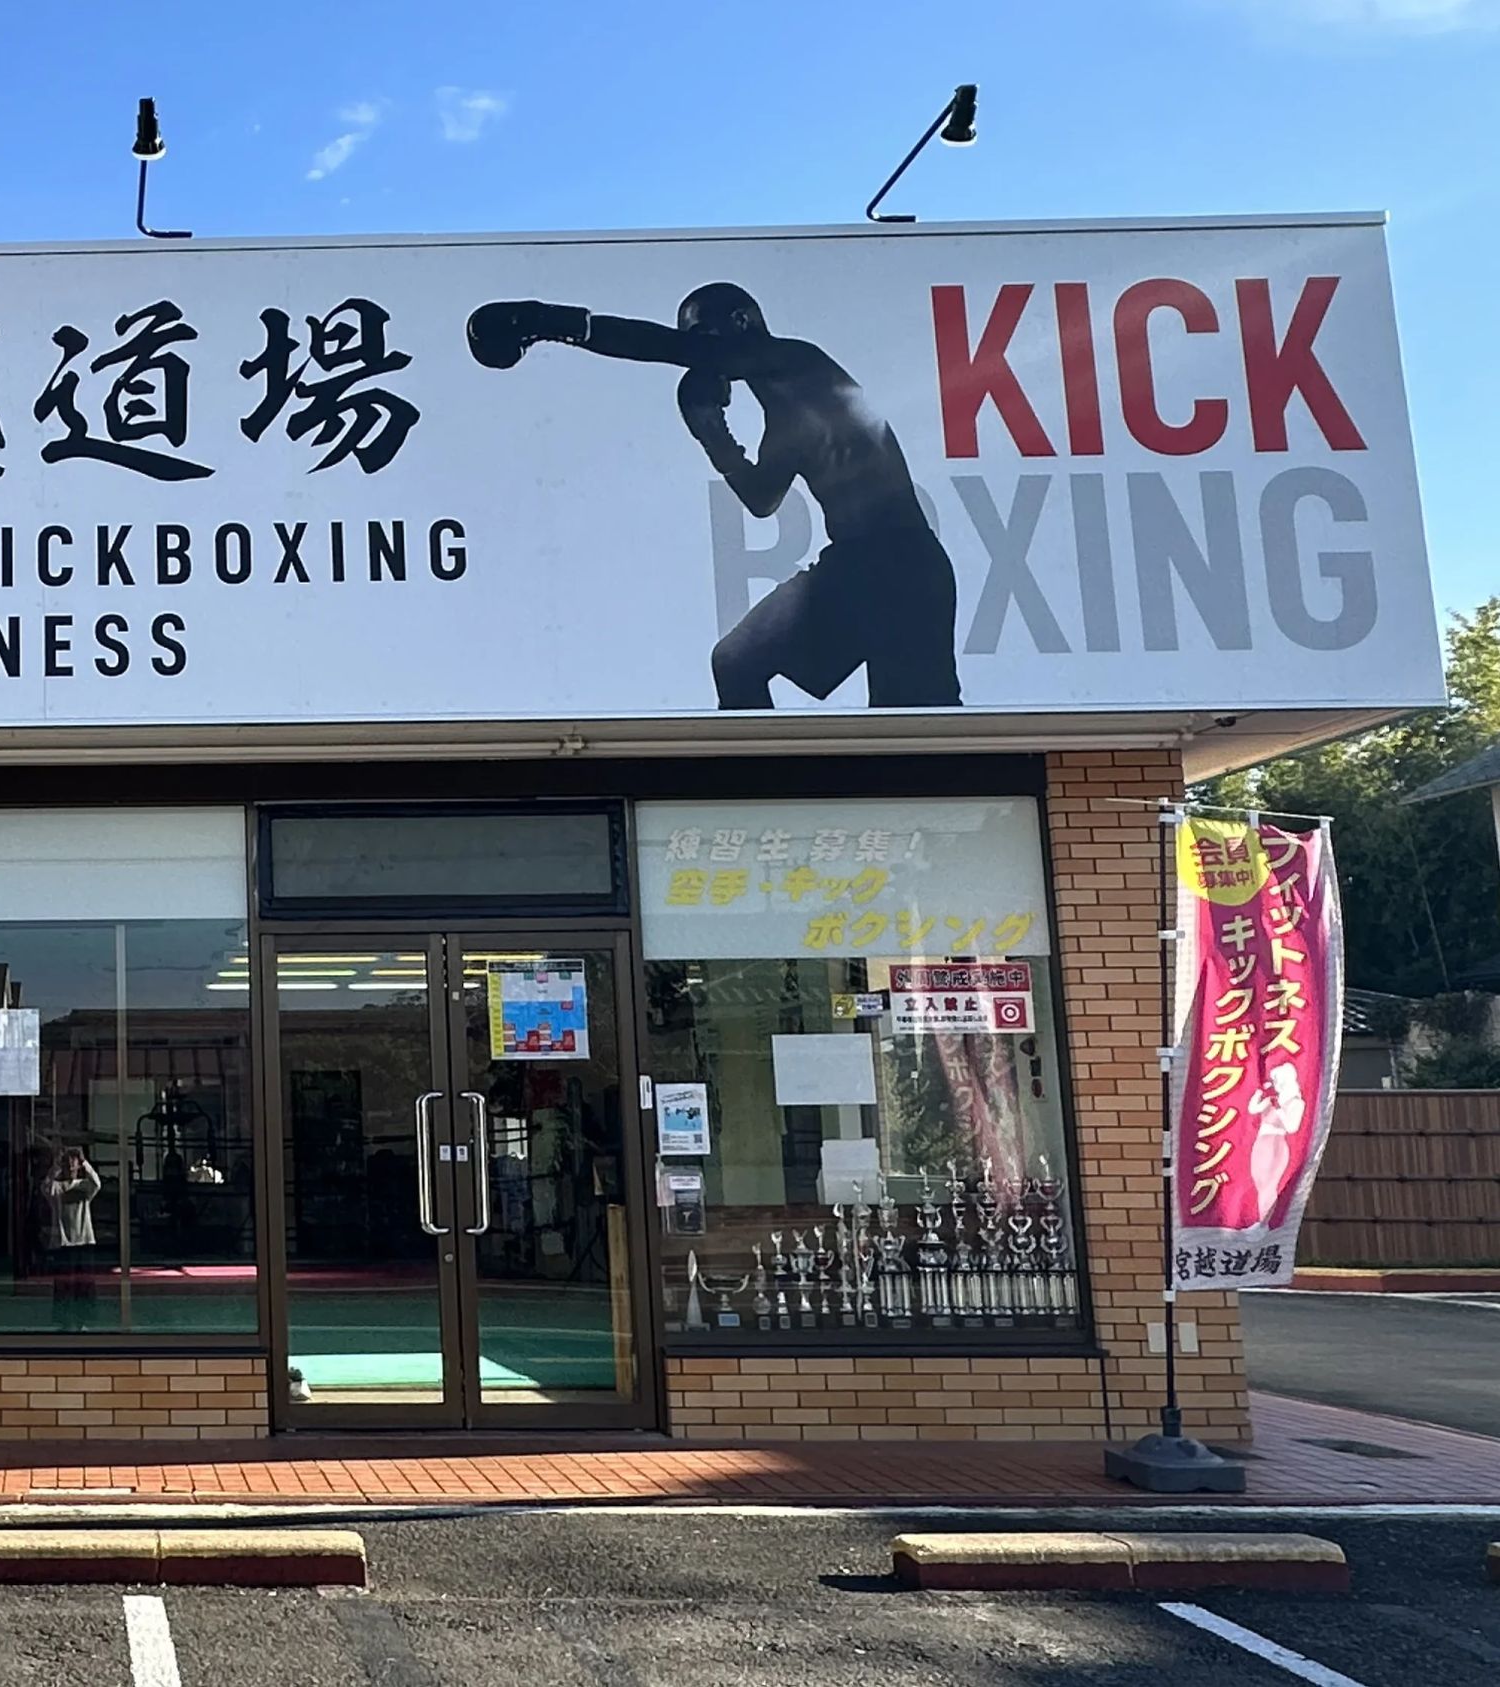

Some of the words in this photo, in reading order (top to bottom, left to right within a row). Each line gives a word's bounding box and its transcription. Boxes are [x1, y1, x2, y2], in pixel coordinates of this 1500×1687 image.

[931, 276, 1368, 458] KICK
[709, 466, 1378, 655] BXING
[804, 911, 1036, 953] ボクシング
[1190, 837, 1251, 866] 会員
[1260, 837, 1306, 1055] フィットネス
[1190, 915, 1255, 1215] キックボクシング
[1175, 1244, 1282, 1280] 宮越道場
